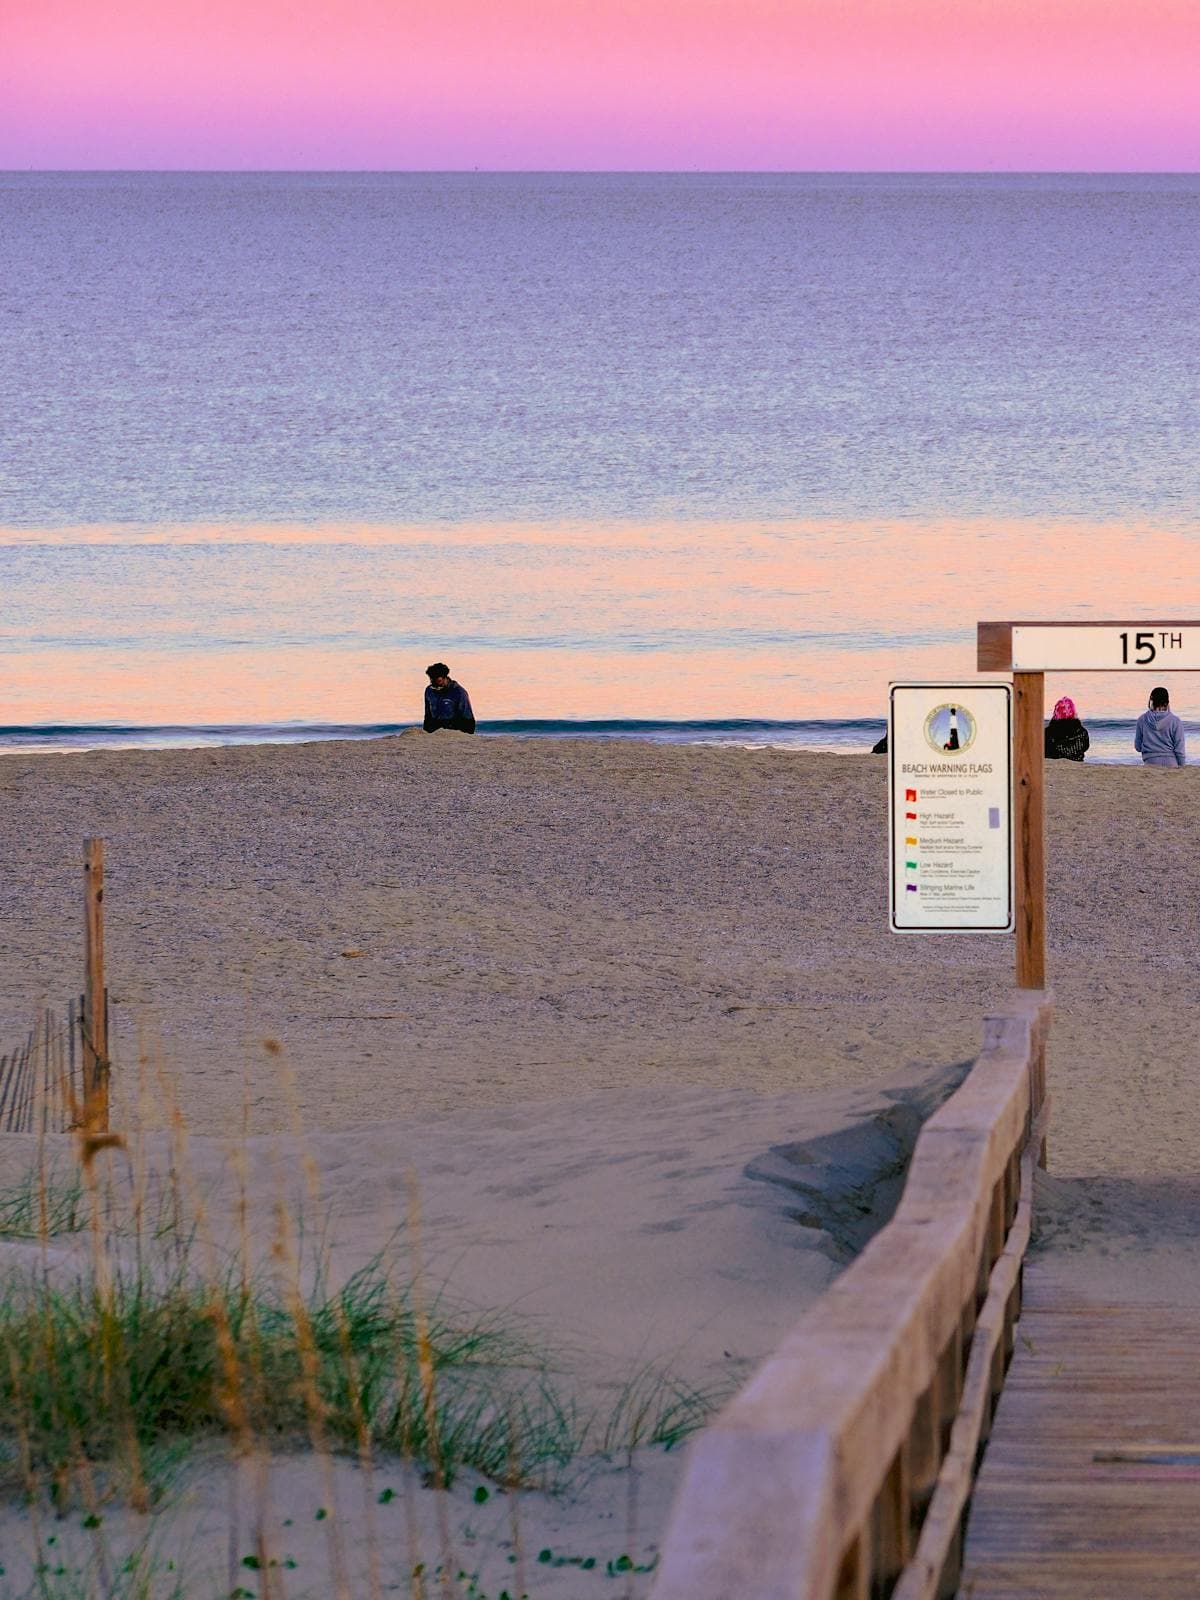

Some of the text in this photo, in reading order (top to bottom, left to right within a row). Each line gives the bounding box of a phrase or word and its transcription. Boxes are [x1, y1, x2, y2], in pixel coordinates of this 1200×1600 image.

[1120, 632, 1182, 664] 15TH
[902, 764, 992, 773] BEACH WARNING FLAGS
